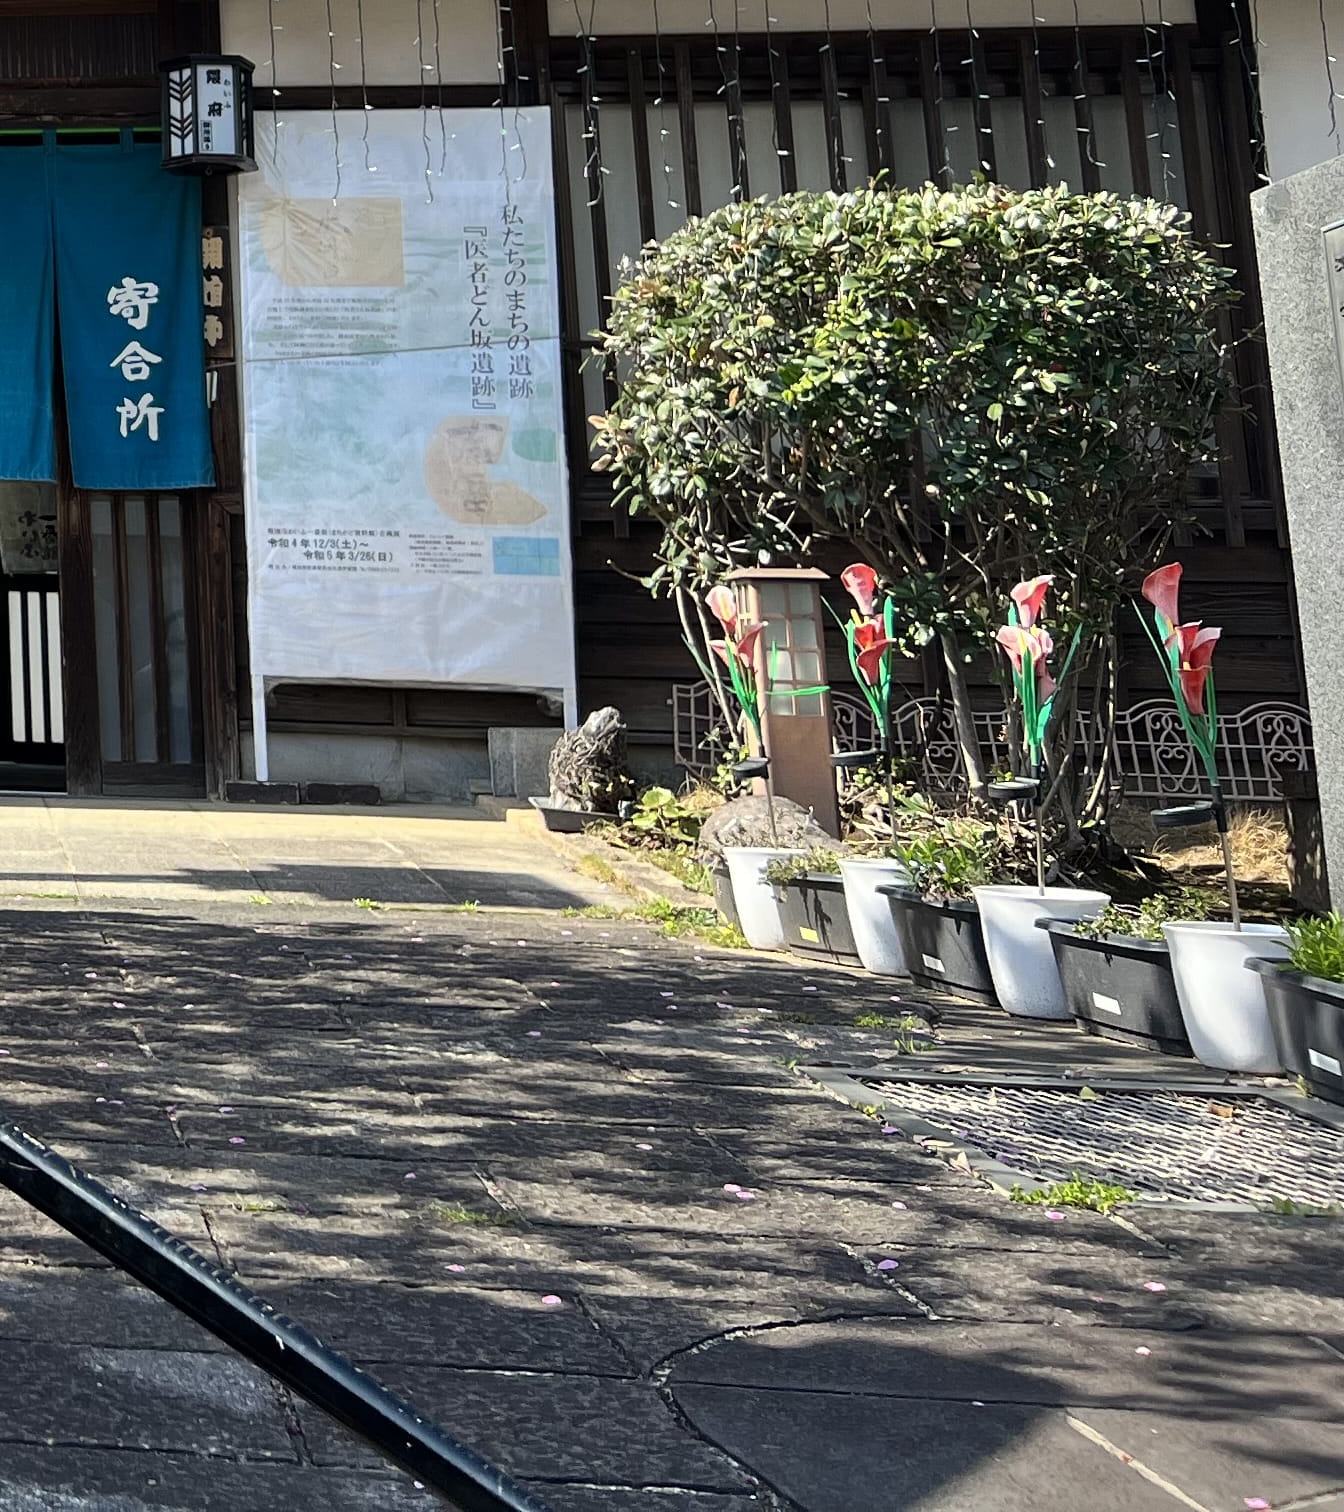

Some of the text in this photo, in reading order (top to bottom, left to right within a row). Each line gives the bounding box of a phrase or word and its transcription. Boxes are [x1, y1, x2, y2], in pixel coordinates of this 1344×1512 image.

[106, 275, 165, 442] 寄合所
[463, 225, 497, 410] 『医者どん坂遺跡』
[501, 204, 534, 399] 私たちのまちの遺跡
